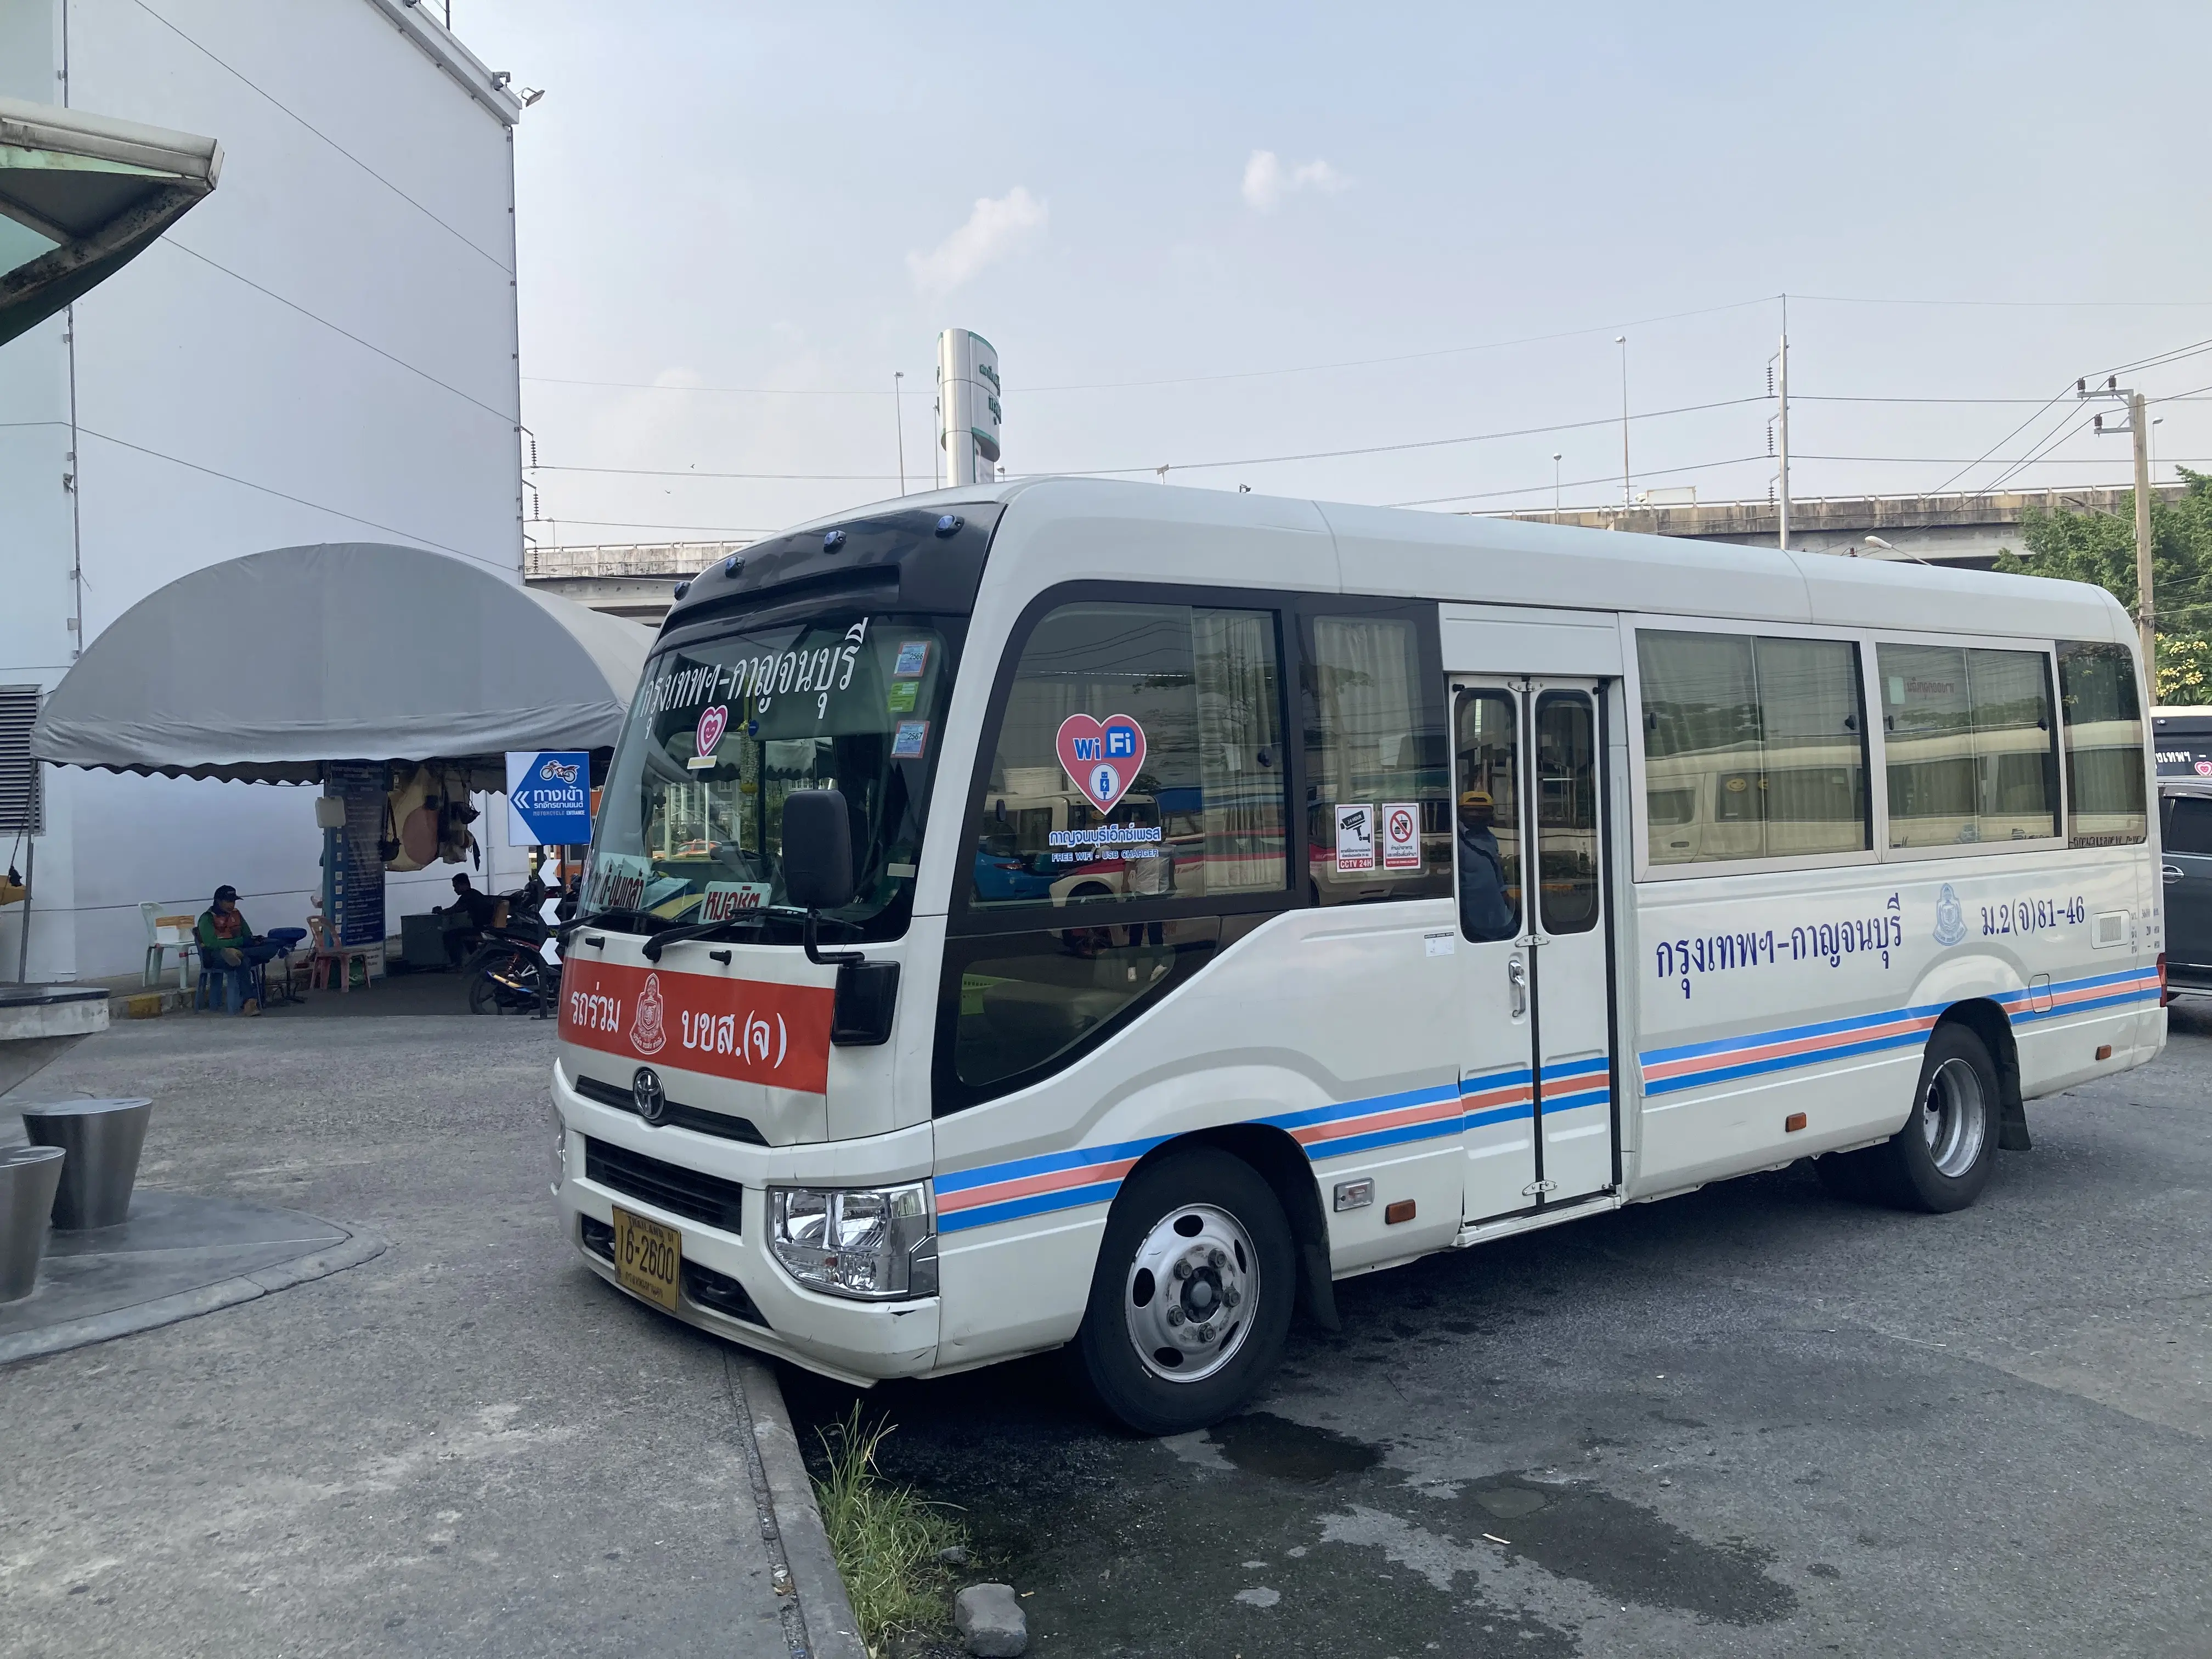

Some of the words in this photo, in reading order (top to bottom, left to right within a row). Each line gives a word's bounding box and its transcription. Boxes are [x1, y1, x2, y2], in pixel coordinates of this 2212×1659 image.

[640, 617, 868, 740] กรุงเทพฯ-กาญจนบุรี
[907, 732, 923, 741] 2567
[534, 786, 583, 802] ทางเข้า
[534, 800, 584, 809] รถจักรยานยนต์
[1049, 822, 1162, 848] กาญจนบุรีเอ็กซ์เพรส
[1052, 852, 1073, 862] FREE
[1076, 851, 1093, 861] WIFI
[1102, 850, 1118, 859] USB
[1121, 849, 1159, 859] CHARGER
[1340, 860, 1357, 868] CCTV
[1359, 859, 1372, 867] 24H
[703, 886, 761, 921] หมอชิต
[1981, 896, 2085, 936] ม.2(จ)81-46
[1656, 892, 1902, 999] กรุงเทพฯ-กาญจนบุรี
[571, 981, 621, 1034] รถร่วม
[620, 1225, 674, 1284] 16-2600
